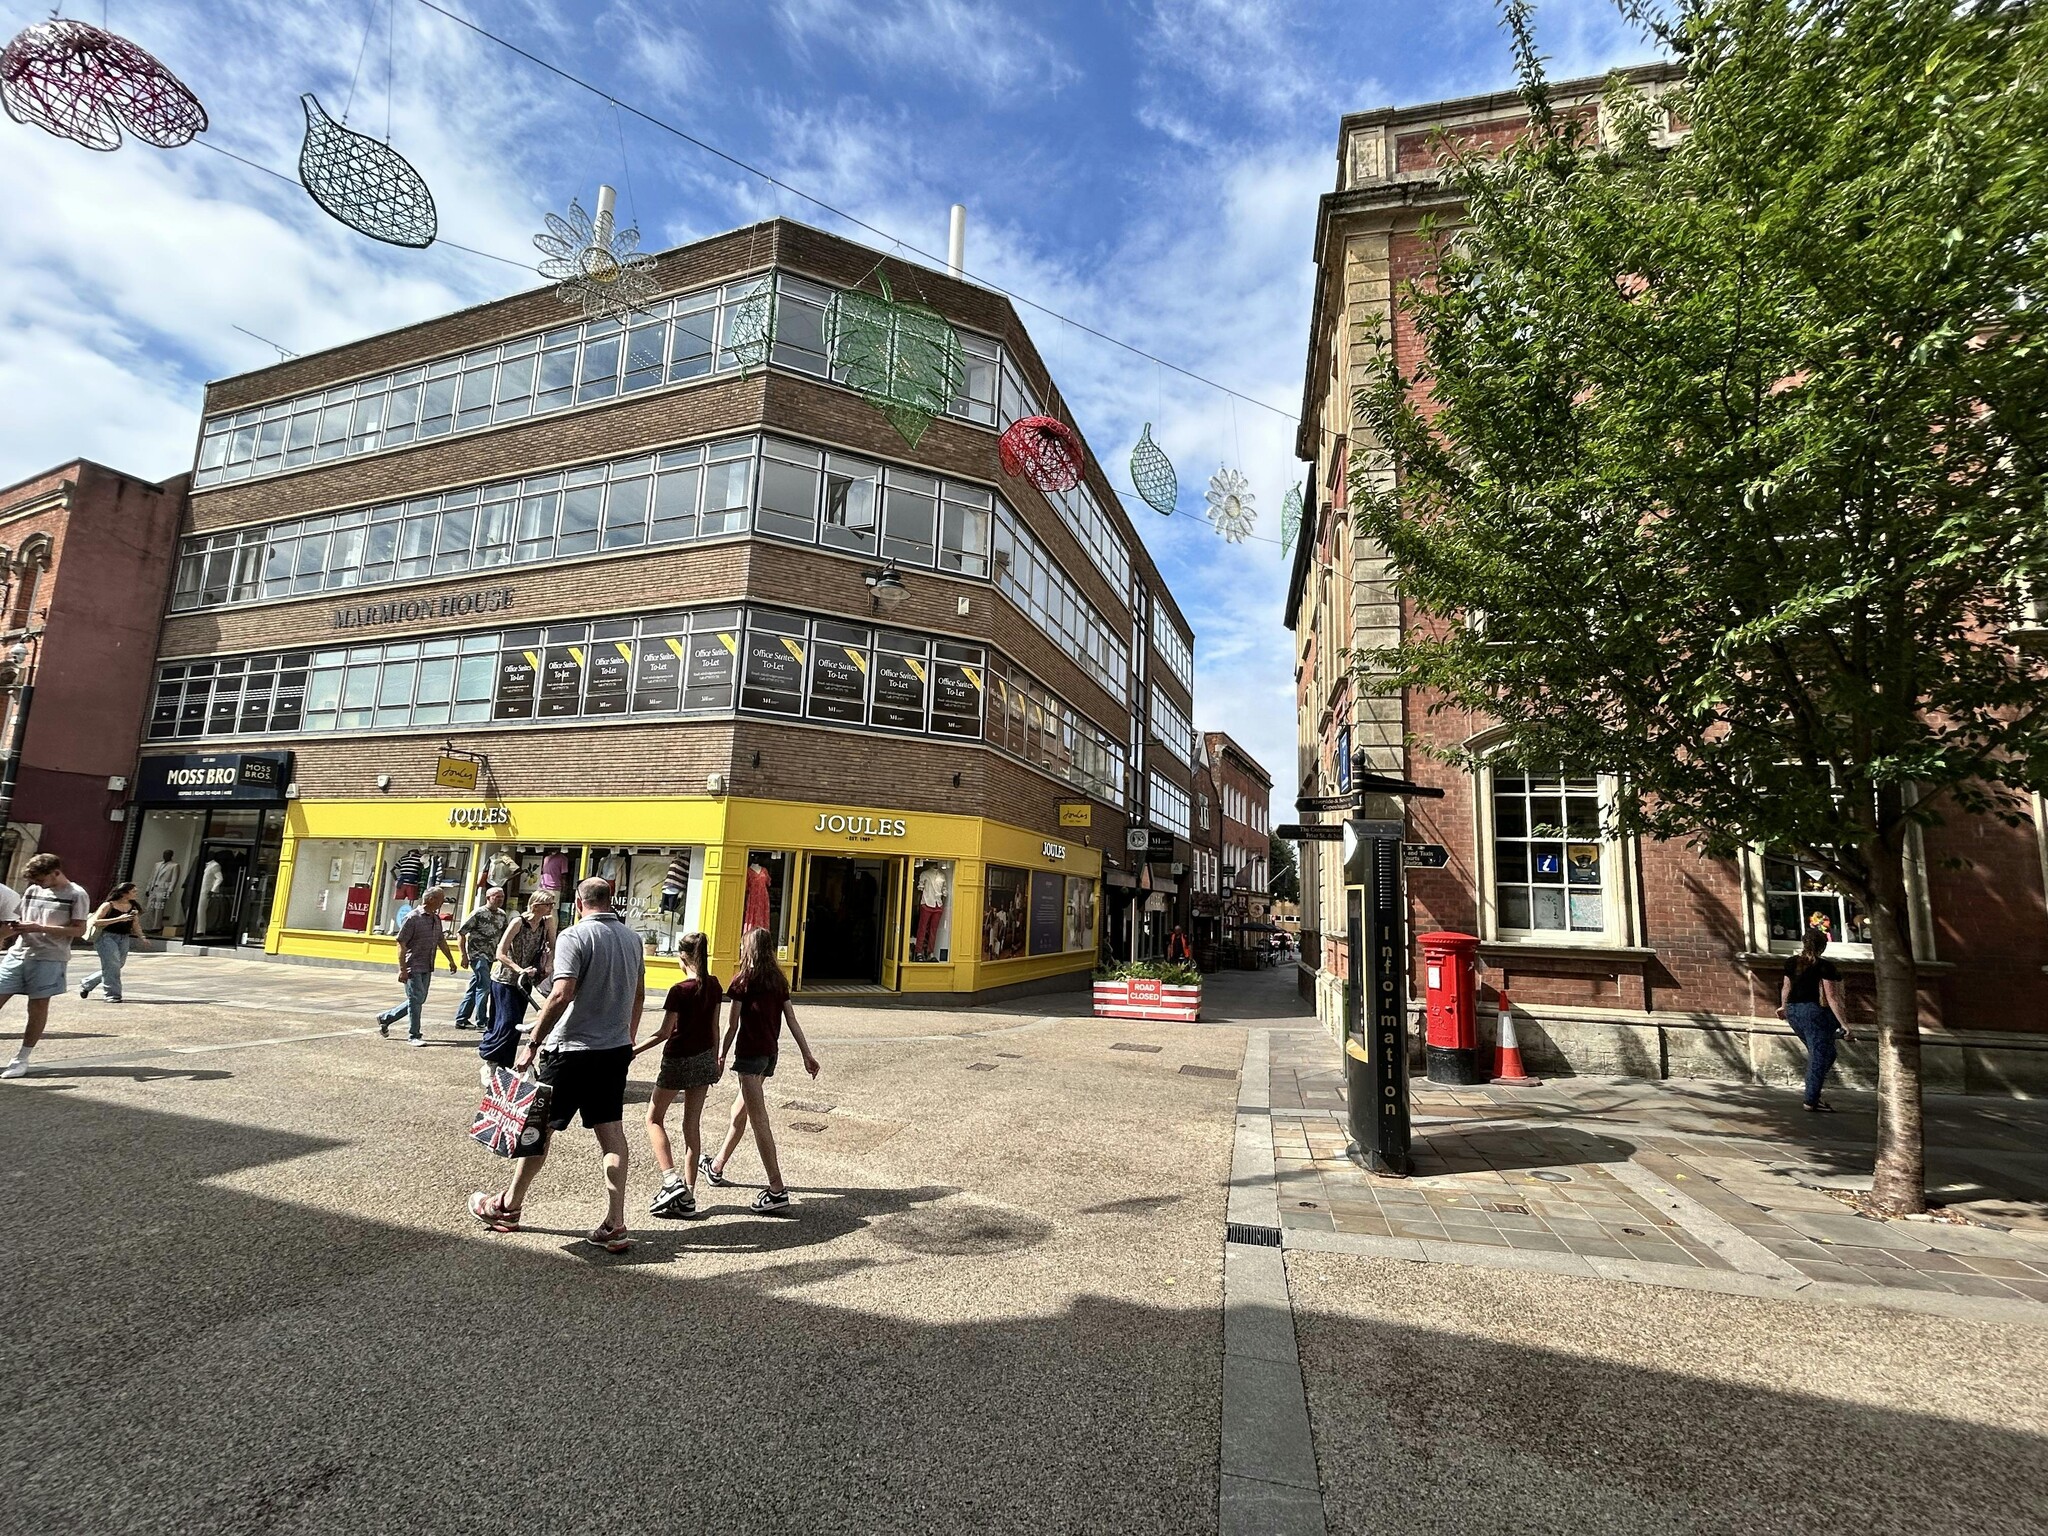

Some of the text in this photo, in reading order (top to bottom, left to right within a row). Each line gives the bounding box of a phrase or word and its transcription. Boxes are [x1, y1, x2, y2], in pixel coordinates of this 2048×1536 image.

[334, 588, 514, 628] MARMION HOUSE
[695, 649, 711, 657] Office
[753, 649, 795, 662] Office Suites
[818, 659, 838, 668] Office
[838, 662, 858, 672] Suites
[880, 668, 917, 681] Office Suites
[938, 677, 974, 689] Office Suites
[246, 764, 271, 772] MOSS
[167, 769, 205, 785] MOSS
[245, 771, 272, 780] BROS.
[448, 808, 508, 823] JOULES
[815, 814, 905, 836] JOULES
[1042, 842, 1066, 859] JOULES
[348, 902, 369, 912] SALE
[629, 897, 646, 907] OFF
[1381, 926, 1396, 1115] Information
